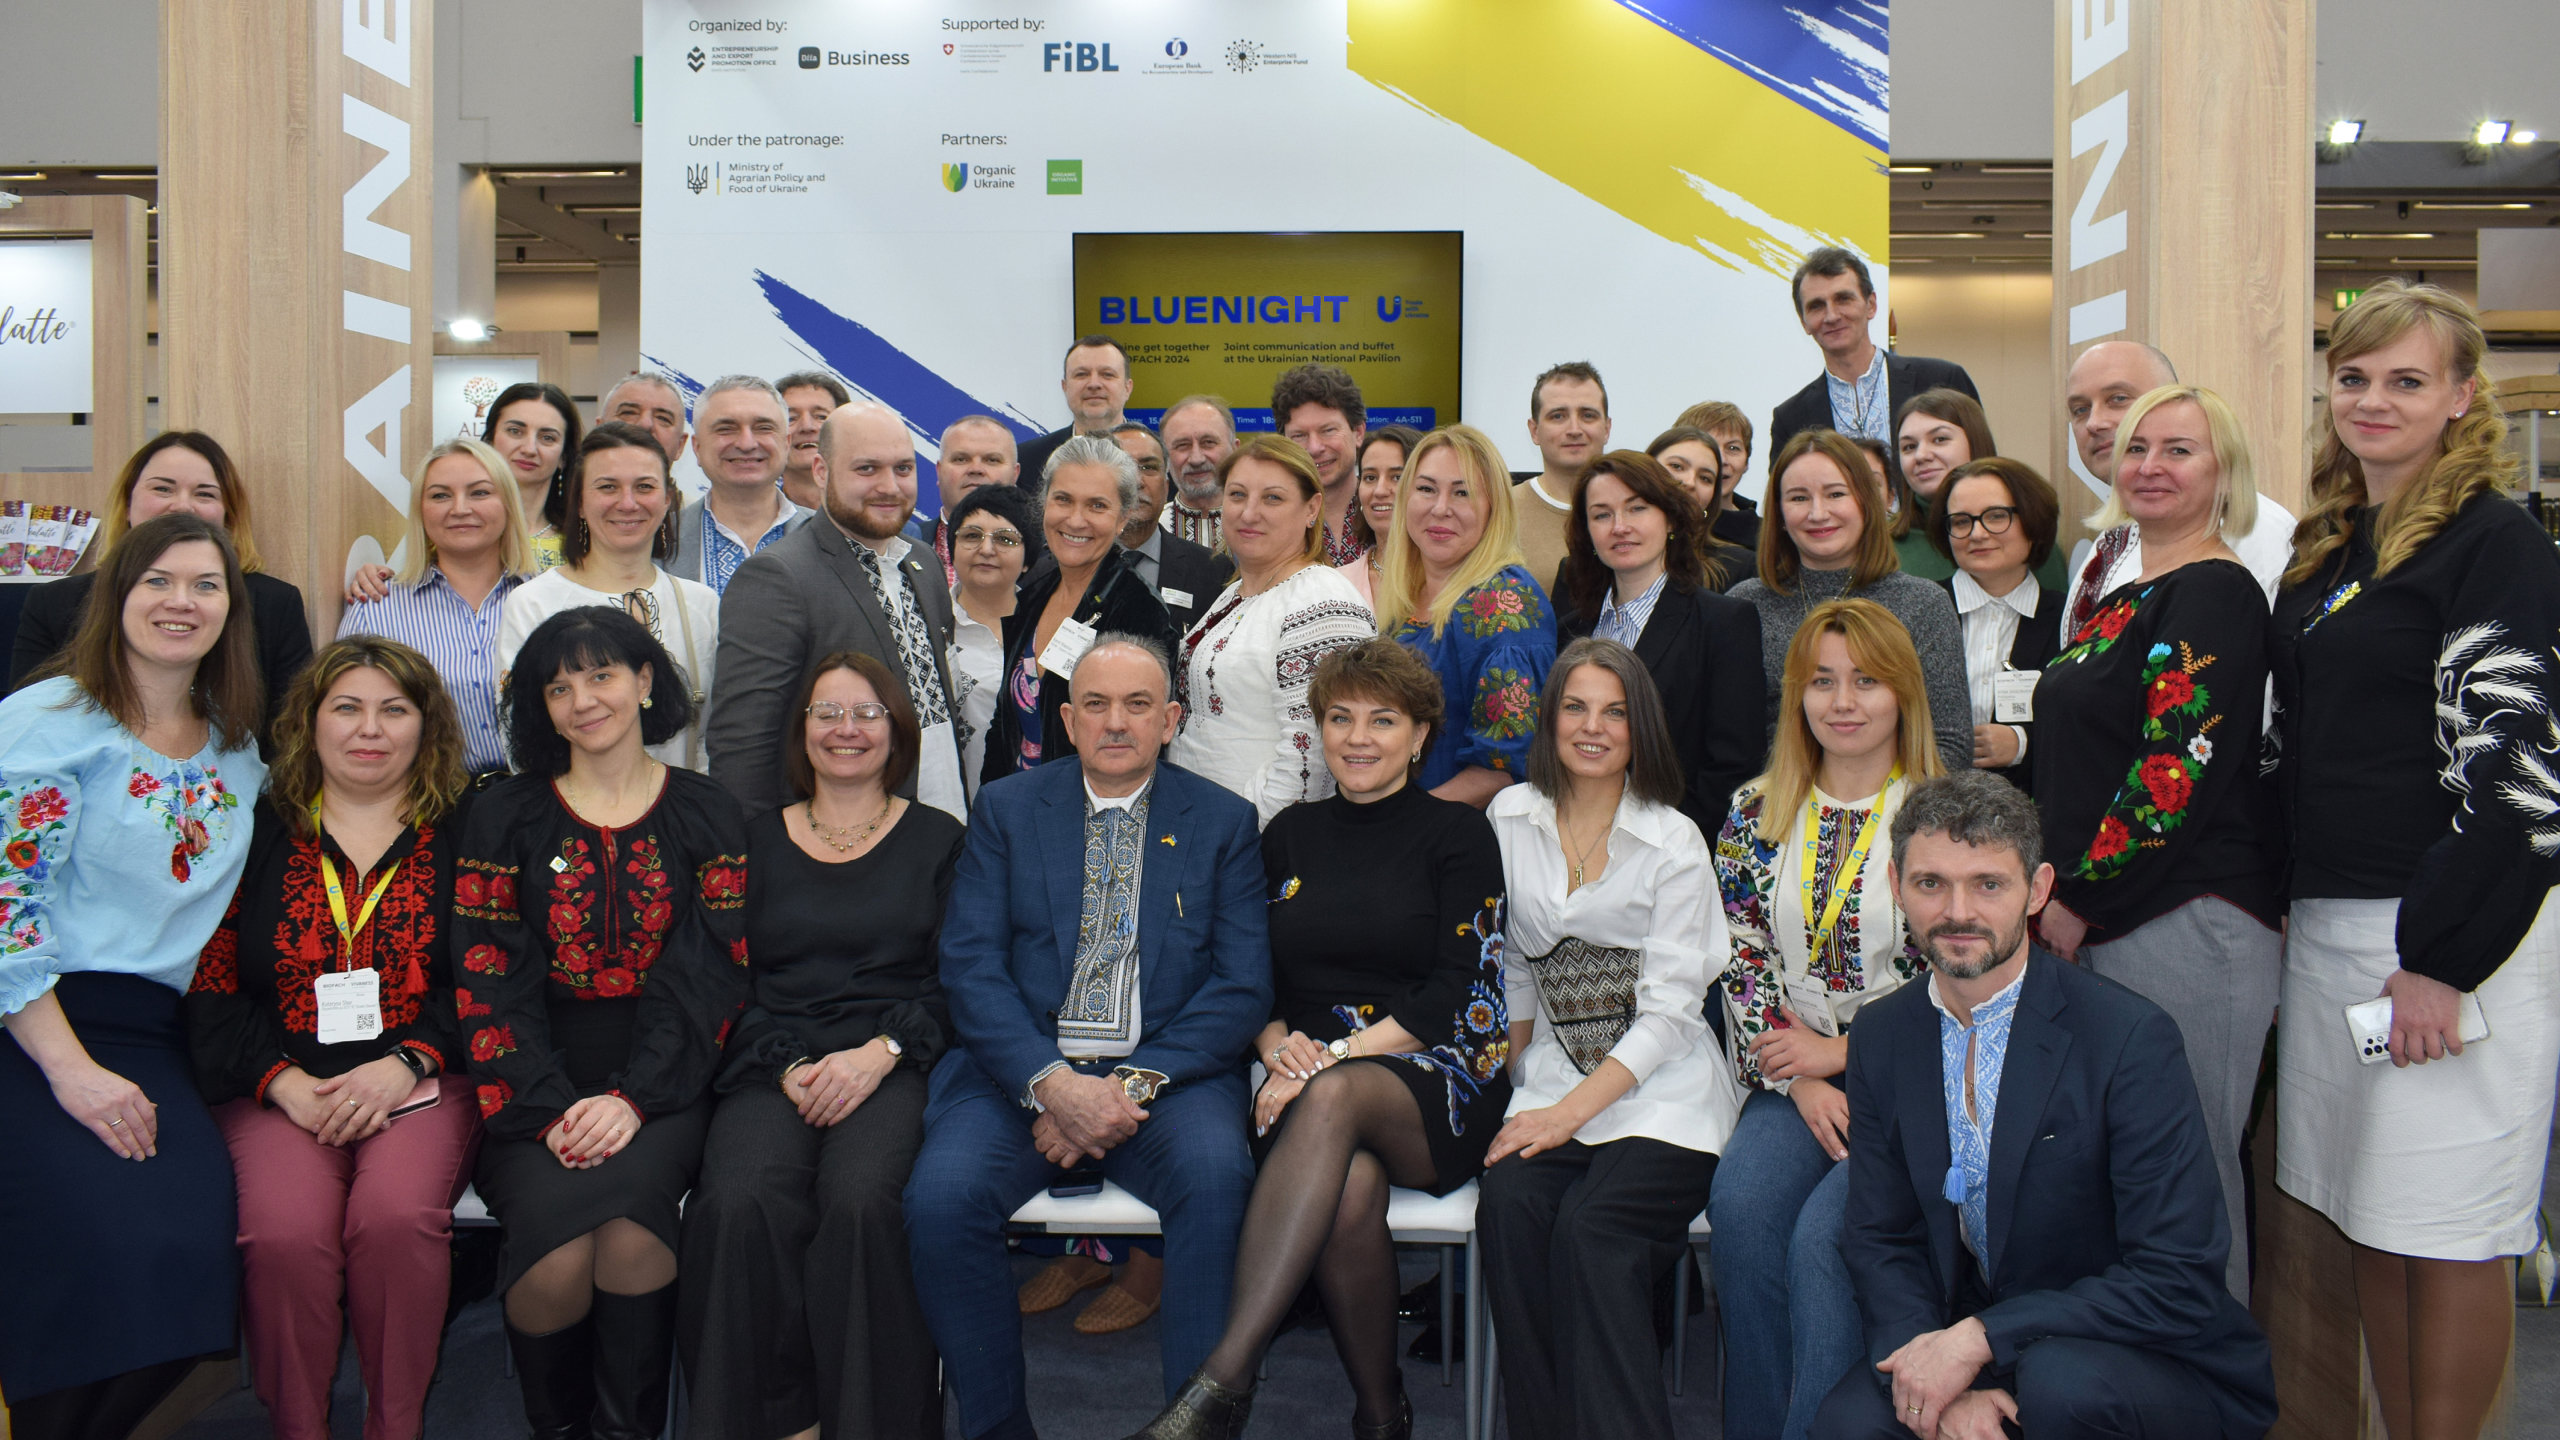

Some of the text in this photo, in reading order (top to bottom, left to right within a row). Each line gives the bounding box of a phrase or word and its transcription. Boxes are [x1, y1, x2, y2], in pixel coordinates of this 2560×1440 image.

[688, 19, 788, 34] Organized by:
[941, 17, 1045, 32] Supported by:
[828, 50, 911, 66] Business
[1043, 40, 1120, 73] FiBL
[688, 134, 845, 149] Under the patronage:
[941, 133, 1007, 146] Partners:
[728, 163, 784, 172] Ministry of
[973, 165, 1016, 177] Organic
[728, 174, 826, 183] Agrarian Policy and
[973, 178, 1015, 189] Ukraine
[728, 185, 808, 193] Food of Ukraine
[1099, 295, 1349, 325] BLUENIGHT
[1143, 344, 1161, 353] get
[1164, 343, 1211, 353] together
[1224, 342, 1395, 351] Joint communication and buffet
[1165, 355, 1190, 364] 2024
[1224, 354, 1401, 363] at the Ukrainian National Pavilion
[1395, 416, 1422, 424] 4A-511
